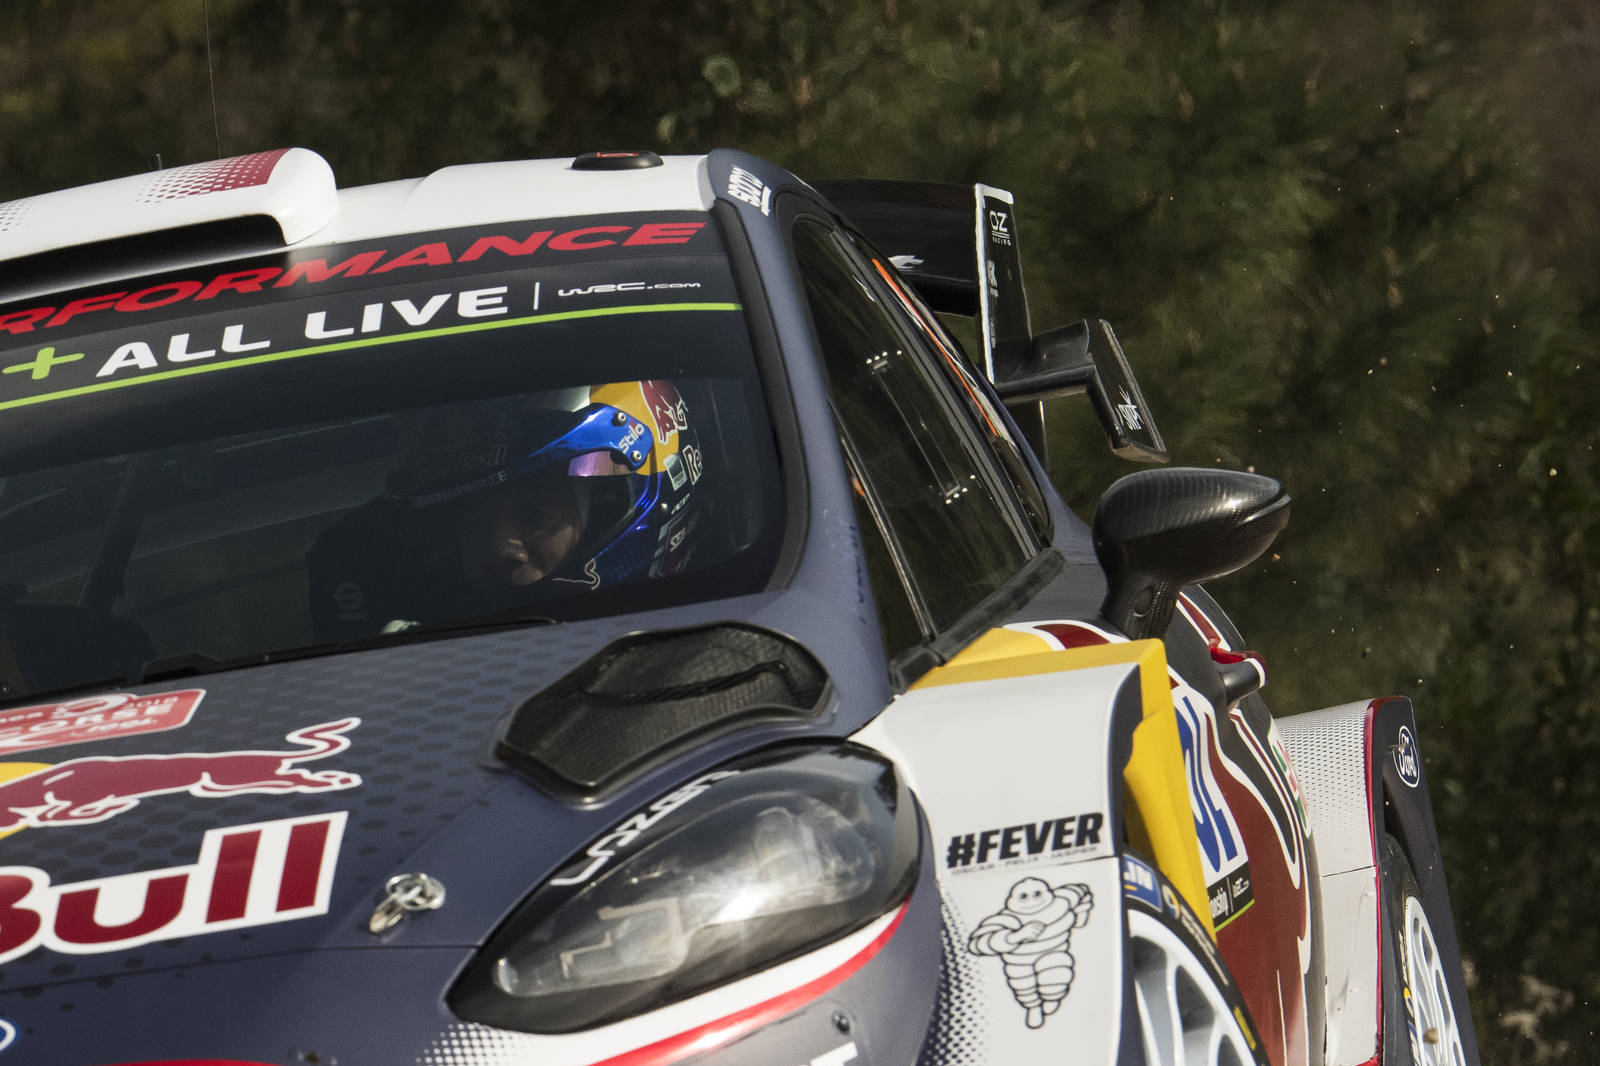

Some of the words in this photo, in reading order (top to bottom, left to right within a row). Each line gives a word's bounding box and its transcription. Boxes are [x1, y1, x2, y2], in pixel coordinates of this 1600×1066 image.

[96, 324, 270, 377] ALL
[304, 286, 508, 340] LIVE
[618, 423, 645, 454] Stilo
[946, 812, 1104, 869] #FEVER
